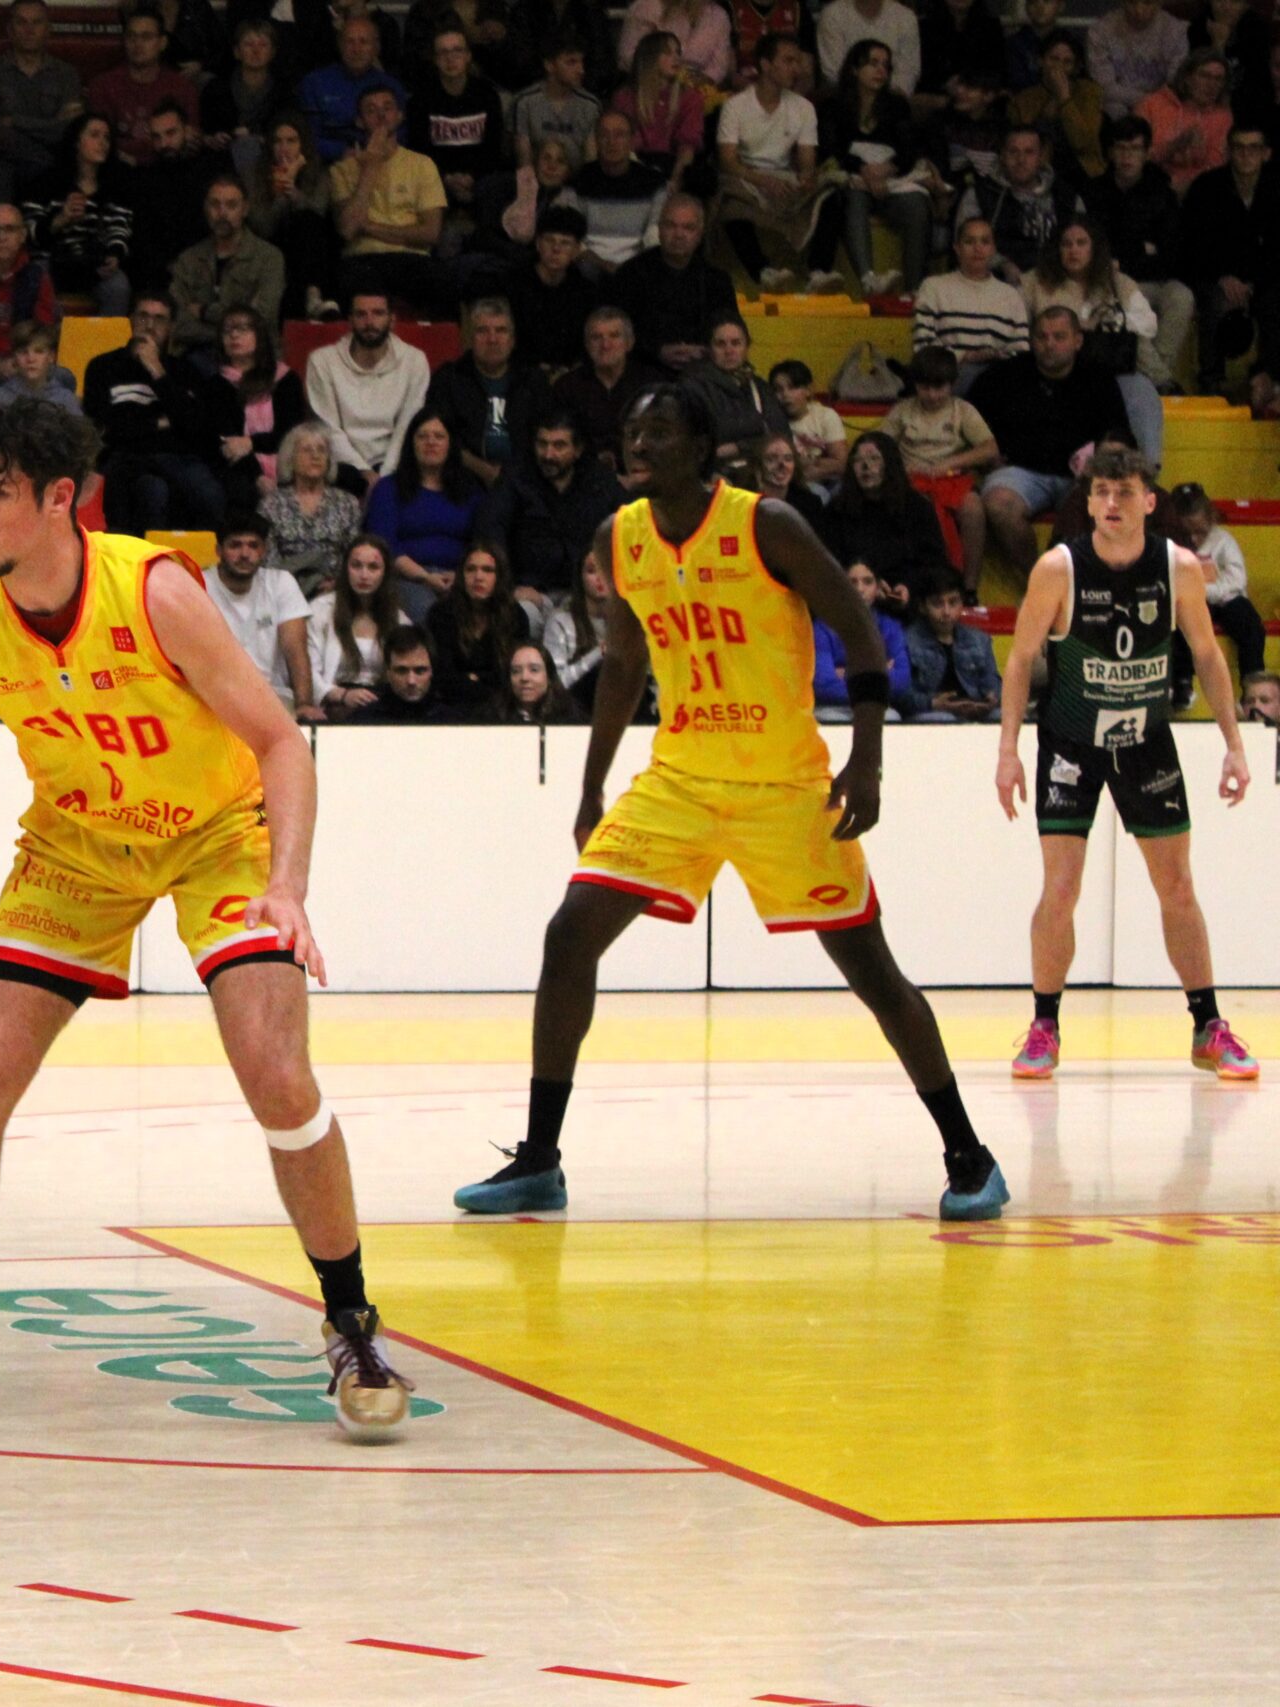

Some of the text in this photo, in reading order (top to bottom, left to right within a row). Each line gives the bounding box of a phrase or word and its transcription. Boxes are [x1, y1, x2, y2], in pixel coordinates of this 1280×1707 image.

[647, 601, 747, 650] SVBD
[1116, 625, 1135, 659] 0
[1086, 659, 1165, 681] TRADIBAT
[693, 703, 768, 721] AESIO
[693, 722, 765, 734] MUTUELLE
[24, 874, 93, 905] VALLIER
